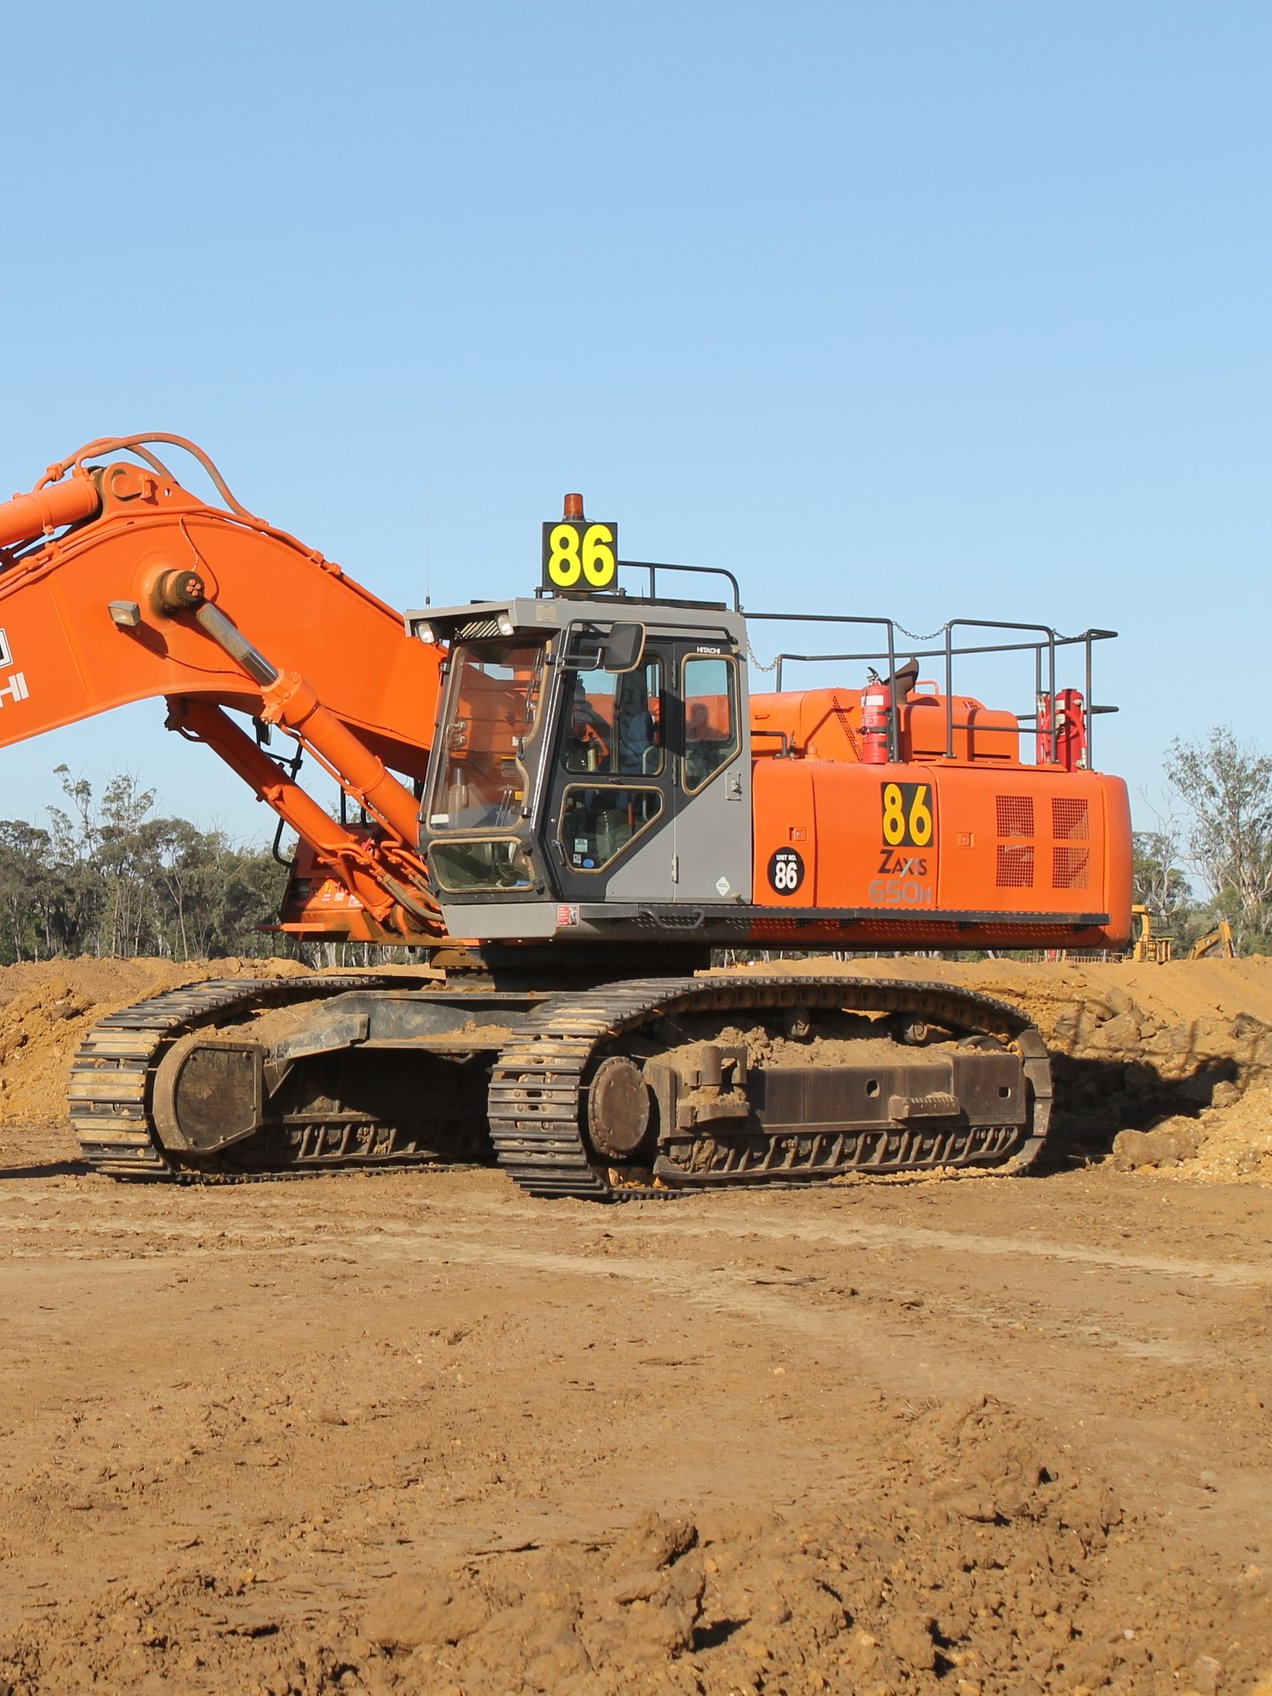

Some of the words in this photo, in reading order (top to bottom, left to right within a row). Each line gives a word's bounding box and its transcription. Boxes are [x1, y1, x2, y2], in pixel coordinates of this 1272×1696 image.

[548, 524, 616, 587] 86
[696, 646, 721, 655] HITACHI
[882, 783, 933, 846] 86
[775, 861, 798, 889] 86
[869, 880, 933, 905] 650H
